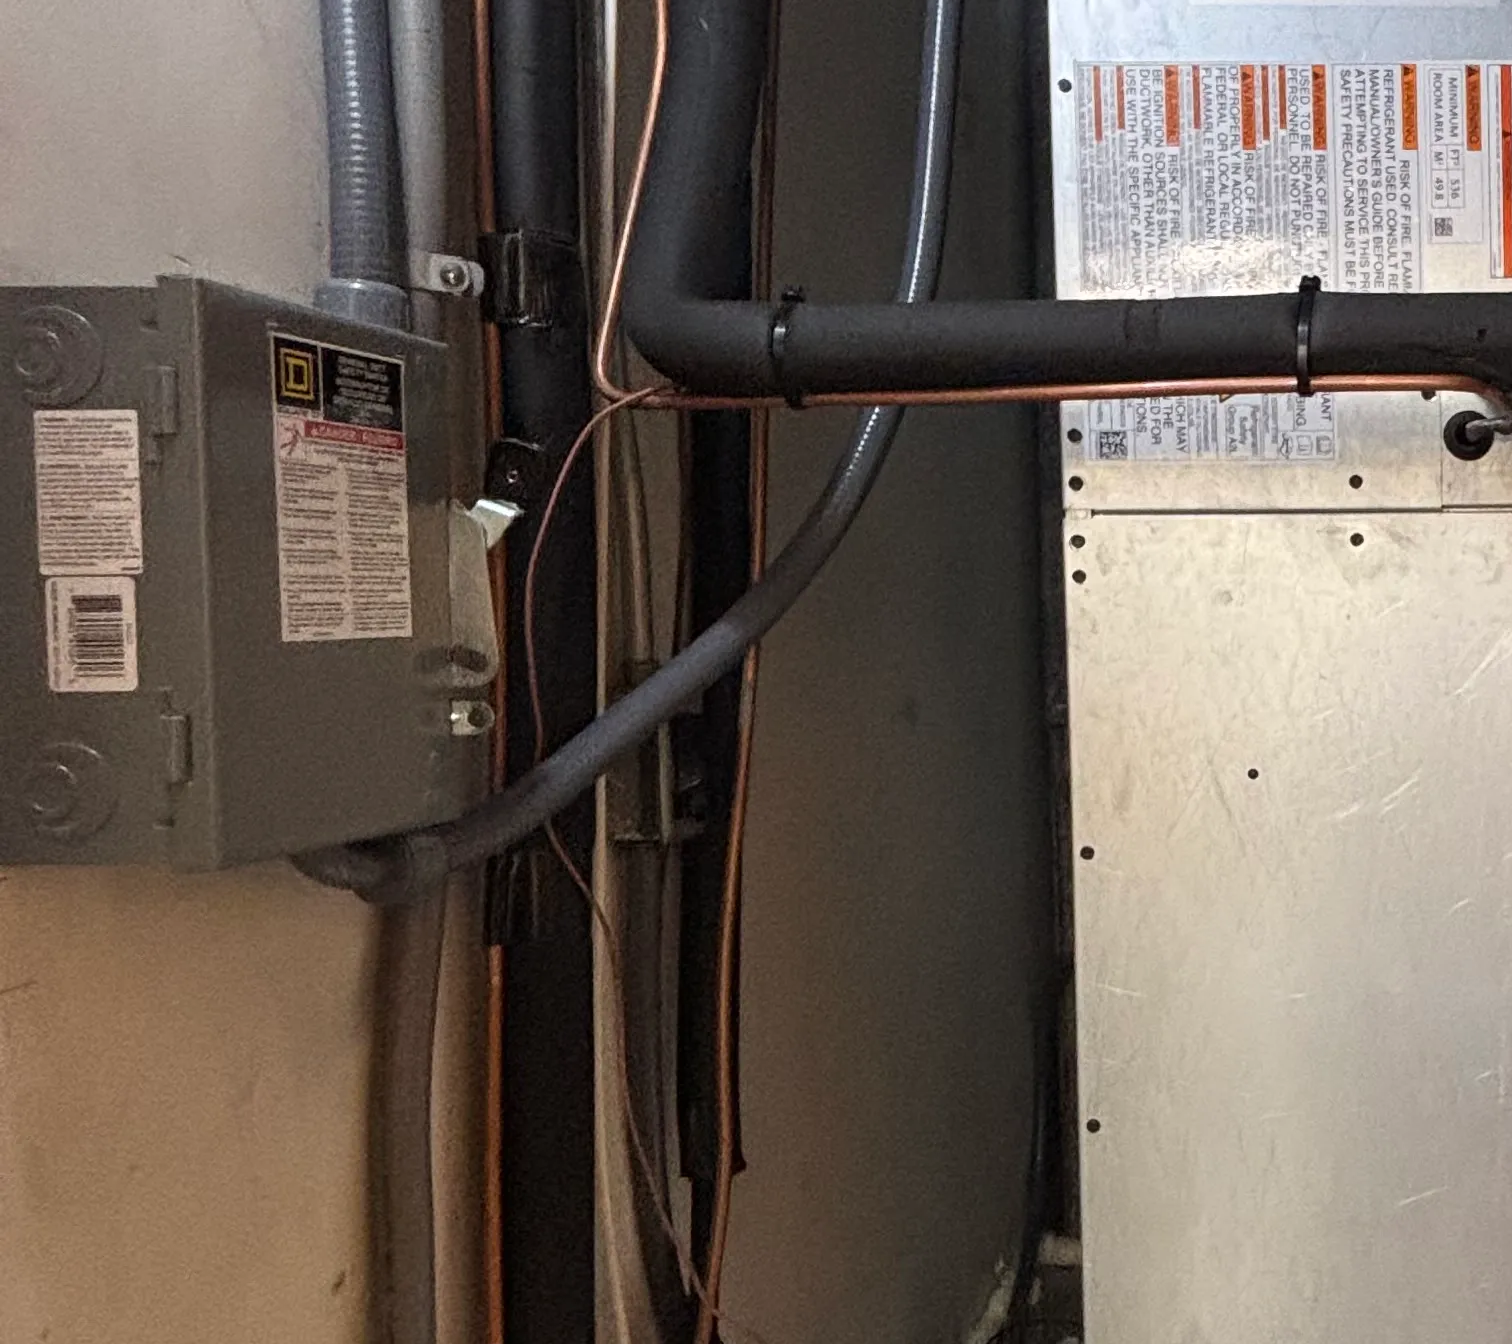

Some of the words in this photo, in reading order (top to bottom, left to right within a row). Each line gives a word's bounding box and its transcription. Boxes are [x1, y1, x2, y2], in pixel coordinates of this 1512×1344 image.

[1126, 69, 1137, 95] USE
[1152, 69, 1163, 87] BE
[1228, 66, 1239, 85] OF
[1216, 67, 1227, 127] FEDERAL
[1340, 69, 1352, 119] SAFETY
[1433, 72, 1443, 110] ROOM
[1127, 99, 1138, 133] WITH
[1140, 69, 1152, 149] DUCTWORK,
[1153, 91, 1164, 147] IGNITION
[1202, 68, 1213, 145] FLAMMABLE
[1300, 113, 1312, 130] TO
[1354, 69, 1367, 153] ATTEMPTING
[1384, 69, 1397, 162] REFRIGERANT
[1448, 77, 1458, 137] MINIMUM
[1228, 88, 1241, 159] PROPERLY
[1369, 69, 1381, 188] MANUAL/OWNER'S
[1434, 112, 1444, 142] AREA
[1128, 137, 1140, 163] THE
[1217, 132, 1228, 152] OR
[1300, 134, 1312, 151] BE
[1142, 153, 1153, 199] OTHER
[1168, 154, 1179, 184] RISK
[1218, 156, 1229, 198] LOCAL
[1231, 162, 1241, 175] IN
[1244, 153, 1256, 183] RISK
[1289, 156, 1300, 174] DO
[1315, 154, 1326, 184] RISK
[1342, 123, 1354, 217] PRECAUTIONS
[1357, 157, 1367, 175] TO
[1399, 160, 1411, 190] RISK
[1130, 166, 1142, 226] SPECIFIC
[1155, 152, 1165, 215] SOURCES
[1168, 188, 1179, 206] OF
[1245, 186, 1256, 205] OF
[1290, 178, 1300, 205] NOT
[1301, 155, 1313, 221] REPAIRED
[1316, 188, 1326, 206] OF
[1450, 179, 1459, 199] 536
[1357, 179, 1369, 235] SERVICE
[1371, 192, 1382, 232] GUIDE
[1401, 194, 1411, 212] OF
[1143, 204, 1154, 237] THAN
[1170, 209, 1180, 238] FIRE
[1317, 210, 1327, 238] FIRE
[1344, 220, 1355, 257] MUST
[1359, 239, 1369, 268] THIS
[1386, 208, 1398, 269] CONSULT
[1345, 261, 1355, 277] BE
[1373, 236, 1384, 288] BEFORE
[1163, 404, 1173, 429] THE
[1151, 419, 1162, 445] FOR
[1176, 427, 1186, 453] MAY
